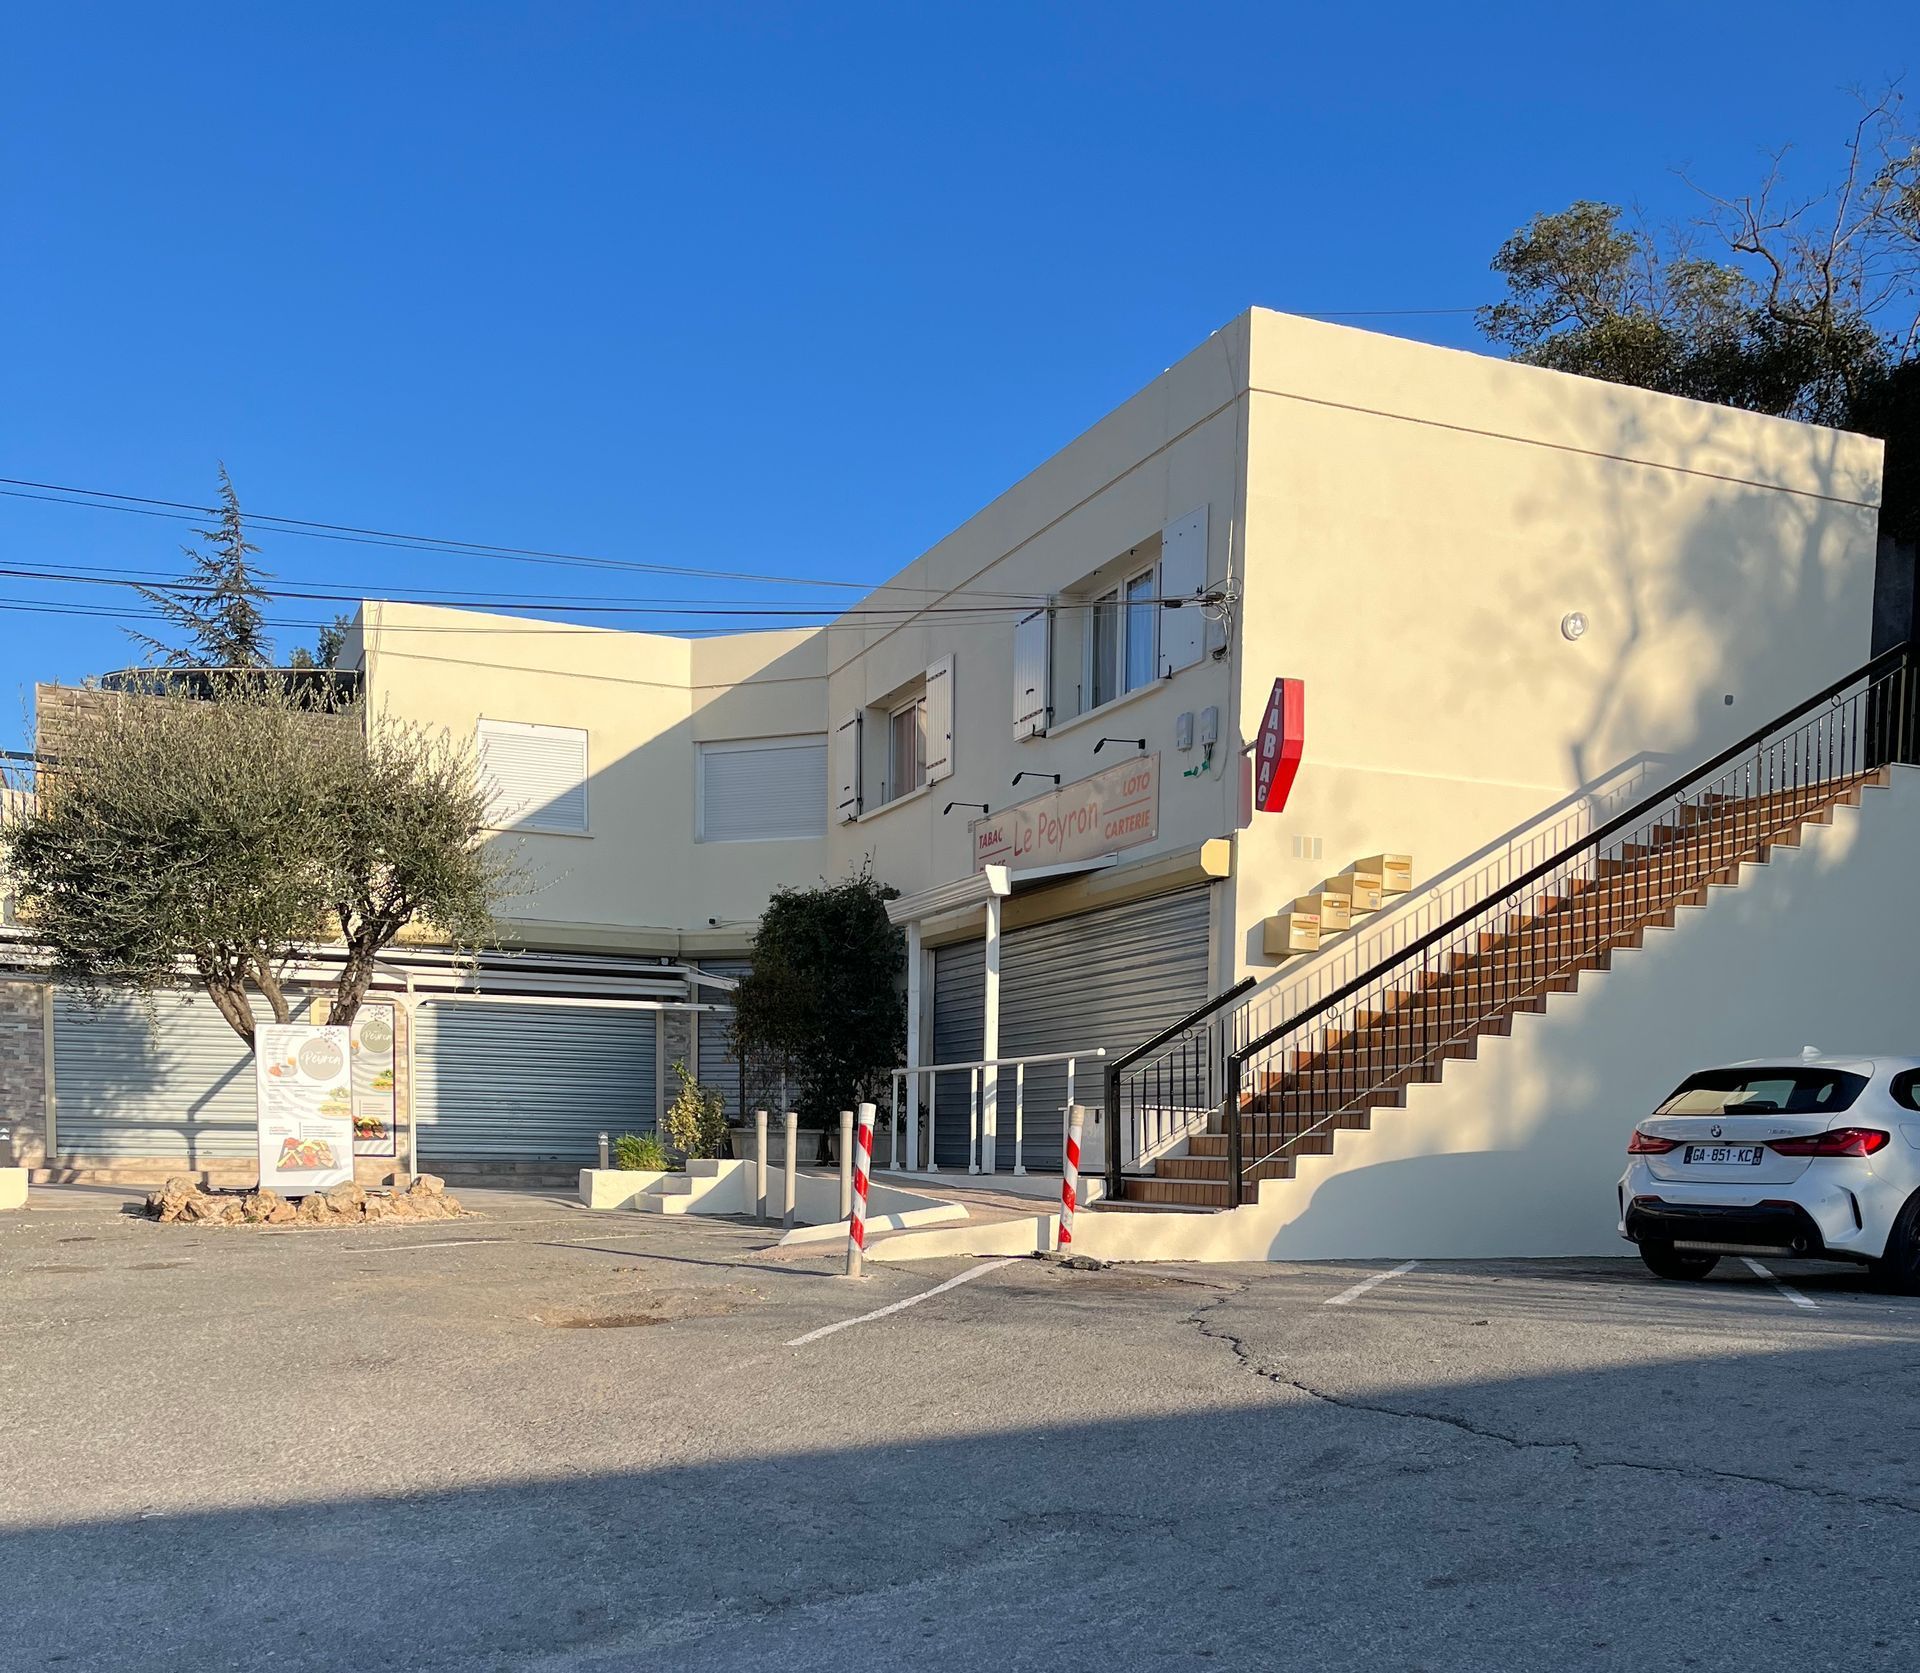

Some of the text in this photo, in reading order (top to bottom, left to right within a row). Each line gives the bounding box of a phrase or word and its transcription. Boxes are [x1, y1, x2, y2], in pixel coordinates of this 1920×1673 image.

[1258, 688, 1282, 802] TABAC
[1123, 772, 1150, 796] LOTO
[979, 827, 1003, 849] TABAC
[1013, 802, 1098, 857] Le Peyron
[1105, 810, 1150, 839] CARTERIE
